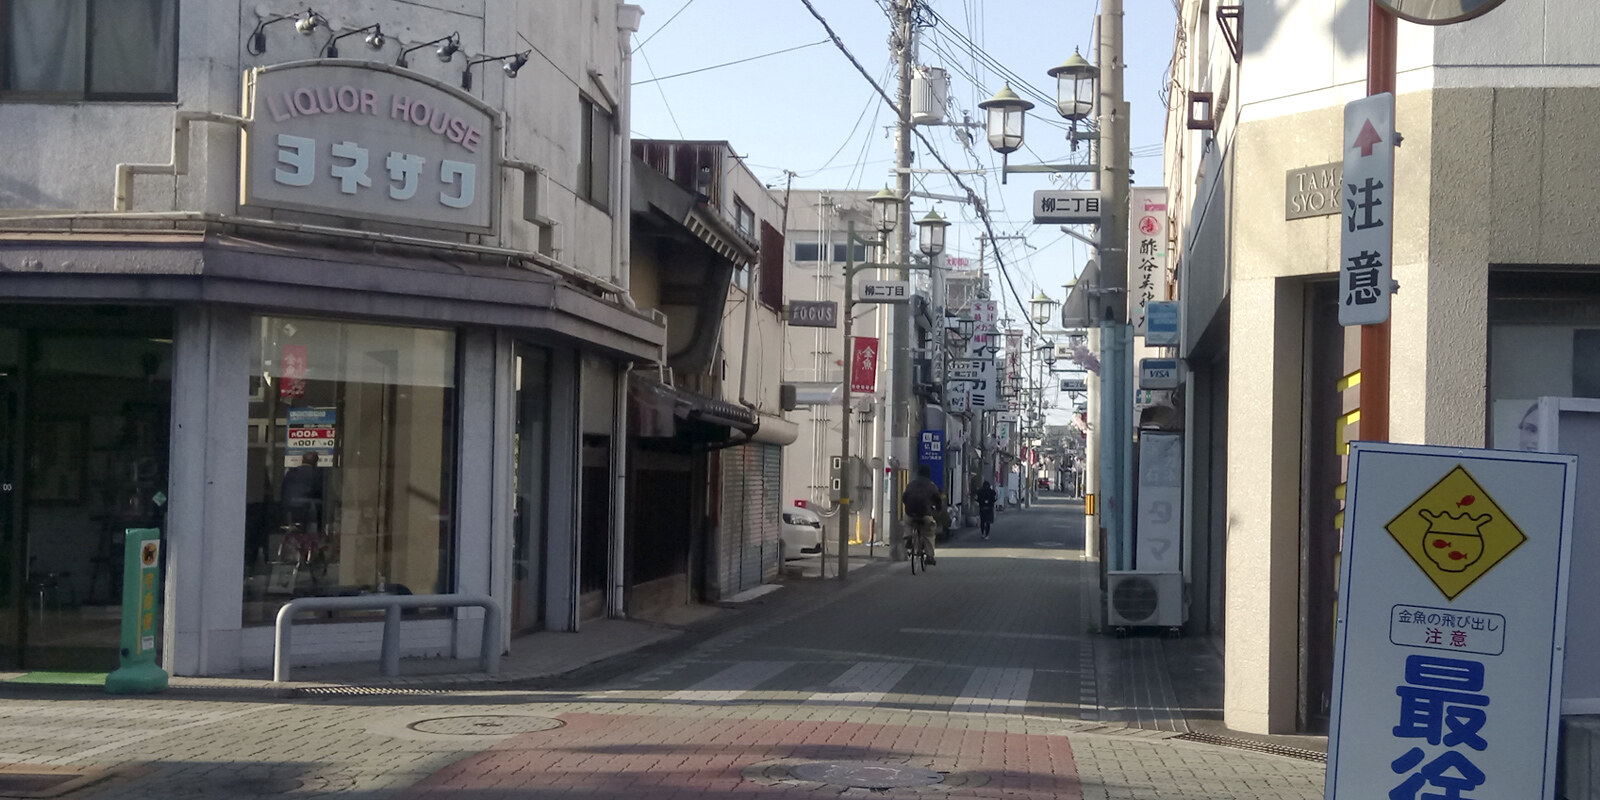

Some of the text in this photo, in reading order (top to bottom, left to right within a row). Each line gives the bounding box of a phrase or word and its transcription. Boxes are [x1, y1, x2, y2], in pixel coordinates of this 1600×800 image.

[267, 85, 482, 153] LIQUOR HOUSE
[1296, 168, 1342, 192] TAM
[1041, 197, 1099, 213] 柳二丁目
[1346, 177, 1384, 306] 注意
[865, 284, 904, 296] 柳二丁目
[793, 306, 832, 321] FOCUS
[1149, 370, 1170, 378] VISA
[1147, 500, 1173, 561] タマ
[1398, 609, 1499, 632] 金魚の飛び出し
[1425, 627, 1467, 648] 注意
